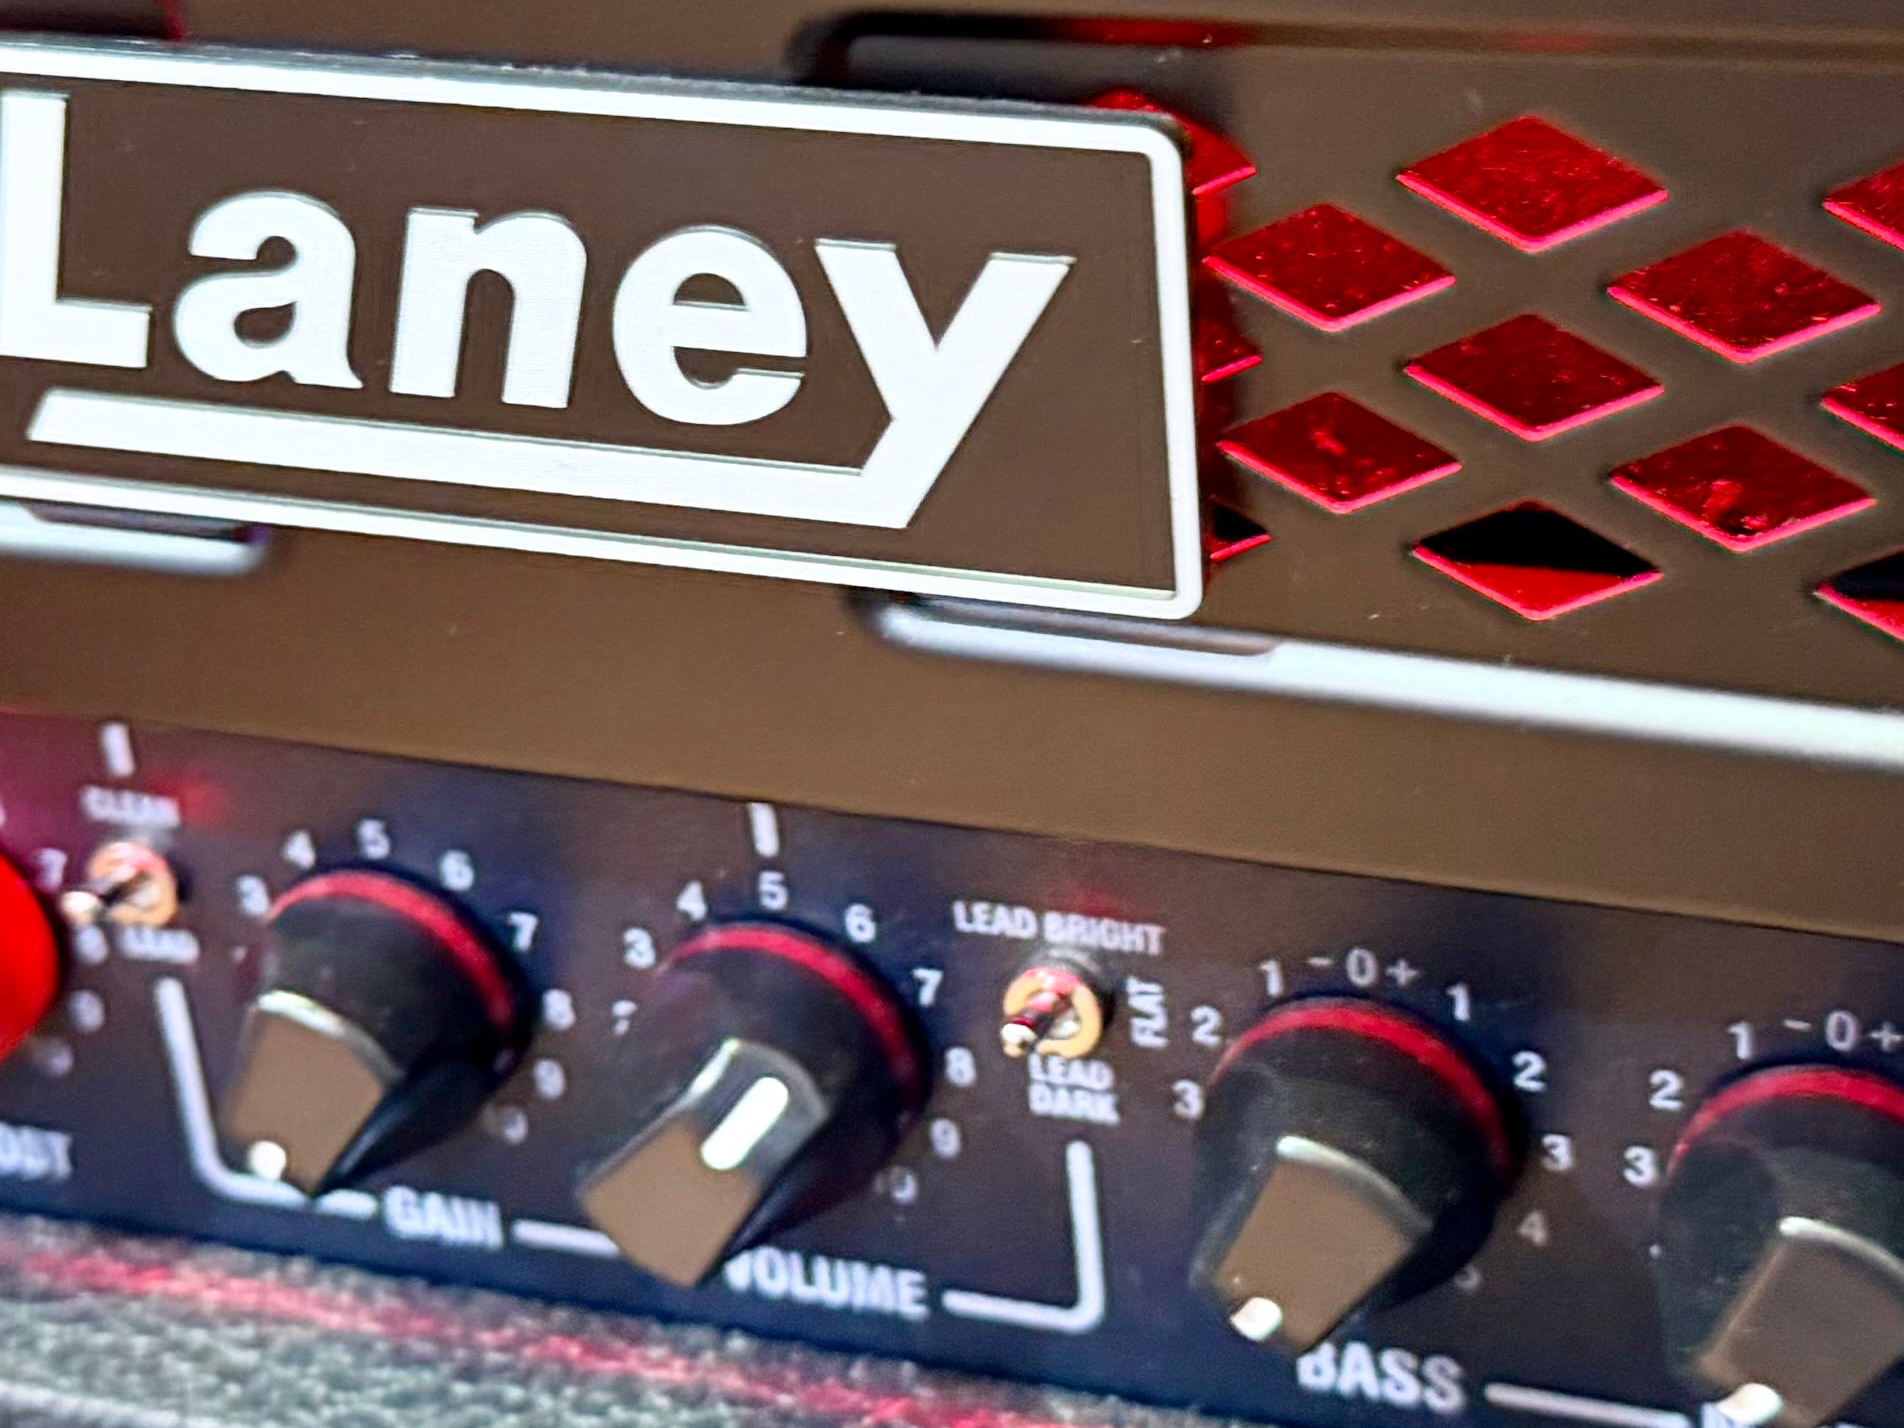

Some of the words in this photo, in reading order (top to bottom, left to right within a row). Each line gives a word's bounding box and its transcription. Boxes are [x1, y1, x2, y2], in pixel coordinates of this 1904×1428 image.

[236, 875, 269, 917] 3
[282, 830, 316, 869] 4
[358, 817, 390, 859] 5
[439, 850, 476, 892] 6
[508, 911, 538, 951] 7
[676, 880, 706, 922] 4
[758, 872, 788, 910] 5
[844, 903, 876, 942] 6
[952, 900, 1036, 941] LEAD
[1042, 910, 1166, 956] BRIGHT
[623, 927, 656, 969] 3
[912, 968, 943, 1006] 7
[1127, 976, 1168, 1048] FLAT
[944, 1047, 976, 1087] 8
[1028, 1053, 1114, 1090] LEAD
[1172, 1079, 1204, 1119] 3
[1190, 1005, 1223, 1046] 2
[1258, 959, 1284, 996] 1
[1446, 982, 1471, 1021] 1
[1512, 1050, 1547, 1092] 2
[1541, 1134, 1574, 1171] 3
[1027, 1085, 1120, 1125] DARK
[1622, 1146, 1658, 1186] 3
[1649, 1069, 1684, 1111] 2
[1727, 1021, 1754, 1060] 1
[930, 1119, 962, 1159] 9
[383, 1185, 504, 1248] GAIN
[723, 1246, 931, 1320] VOLUME
[1296, 1342, 1468, 1412] BASS
